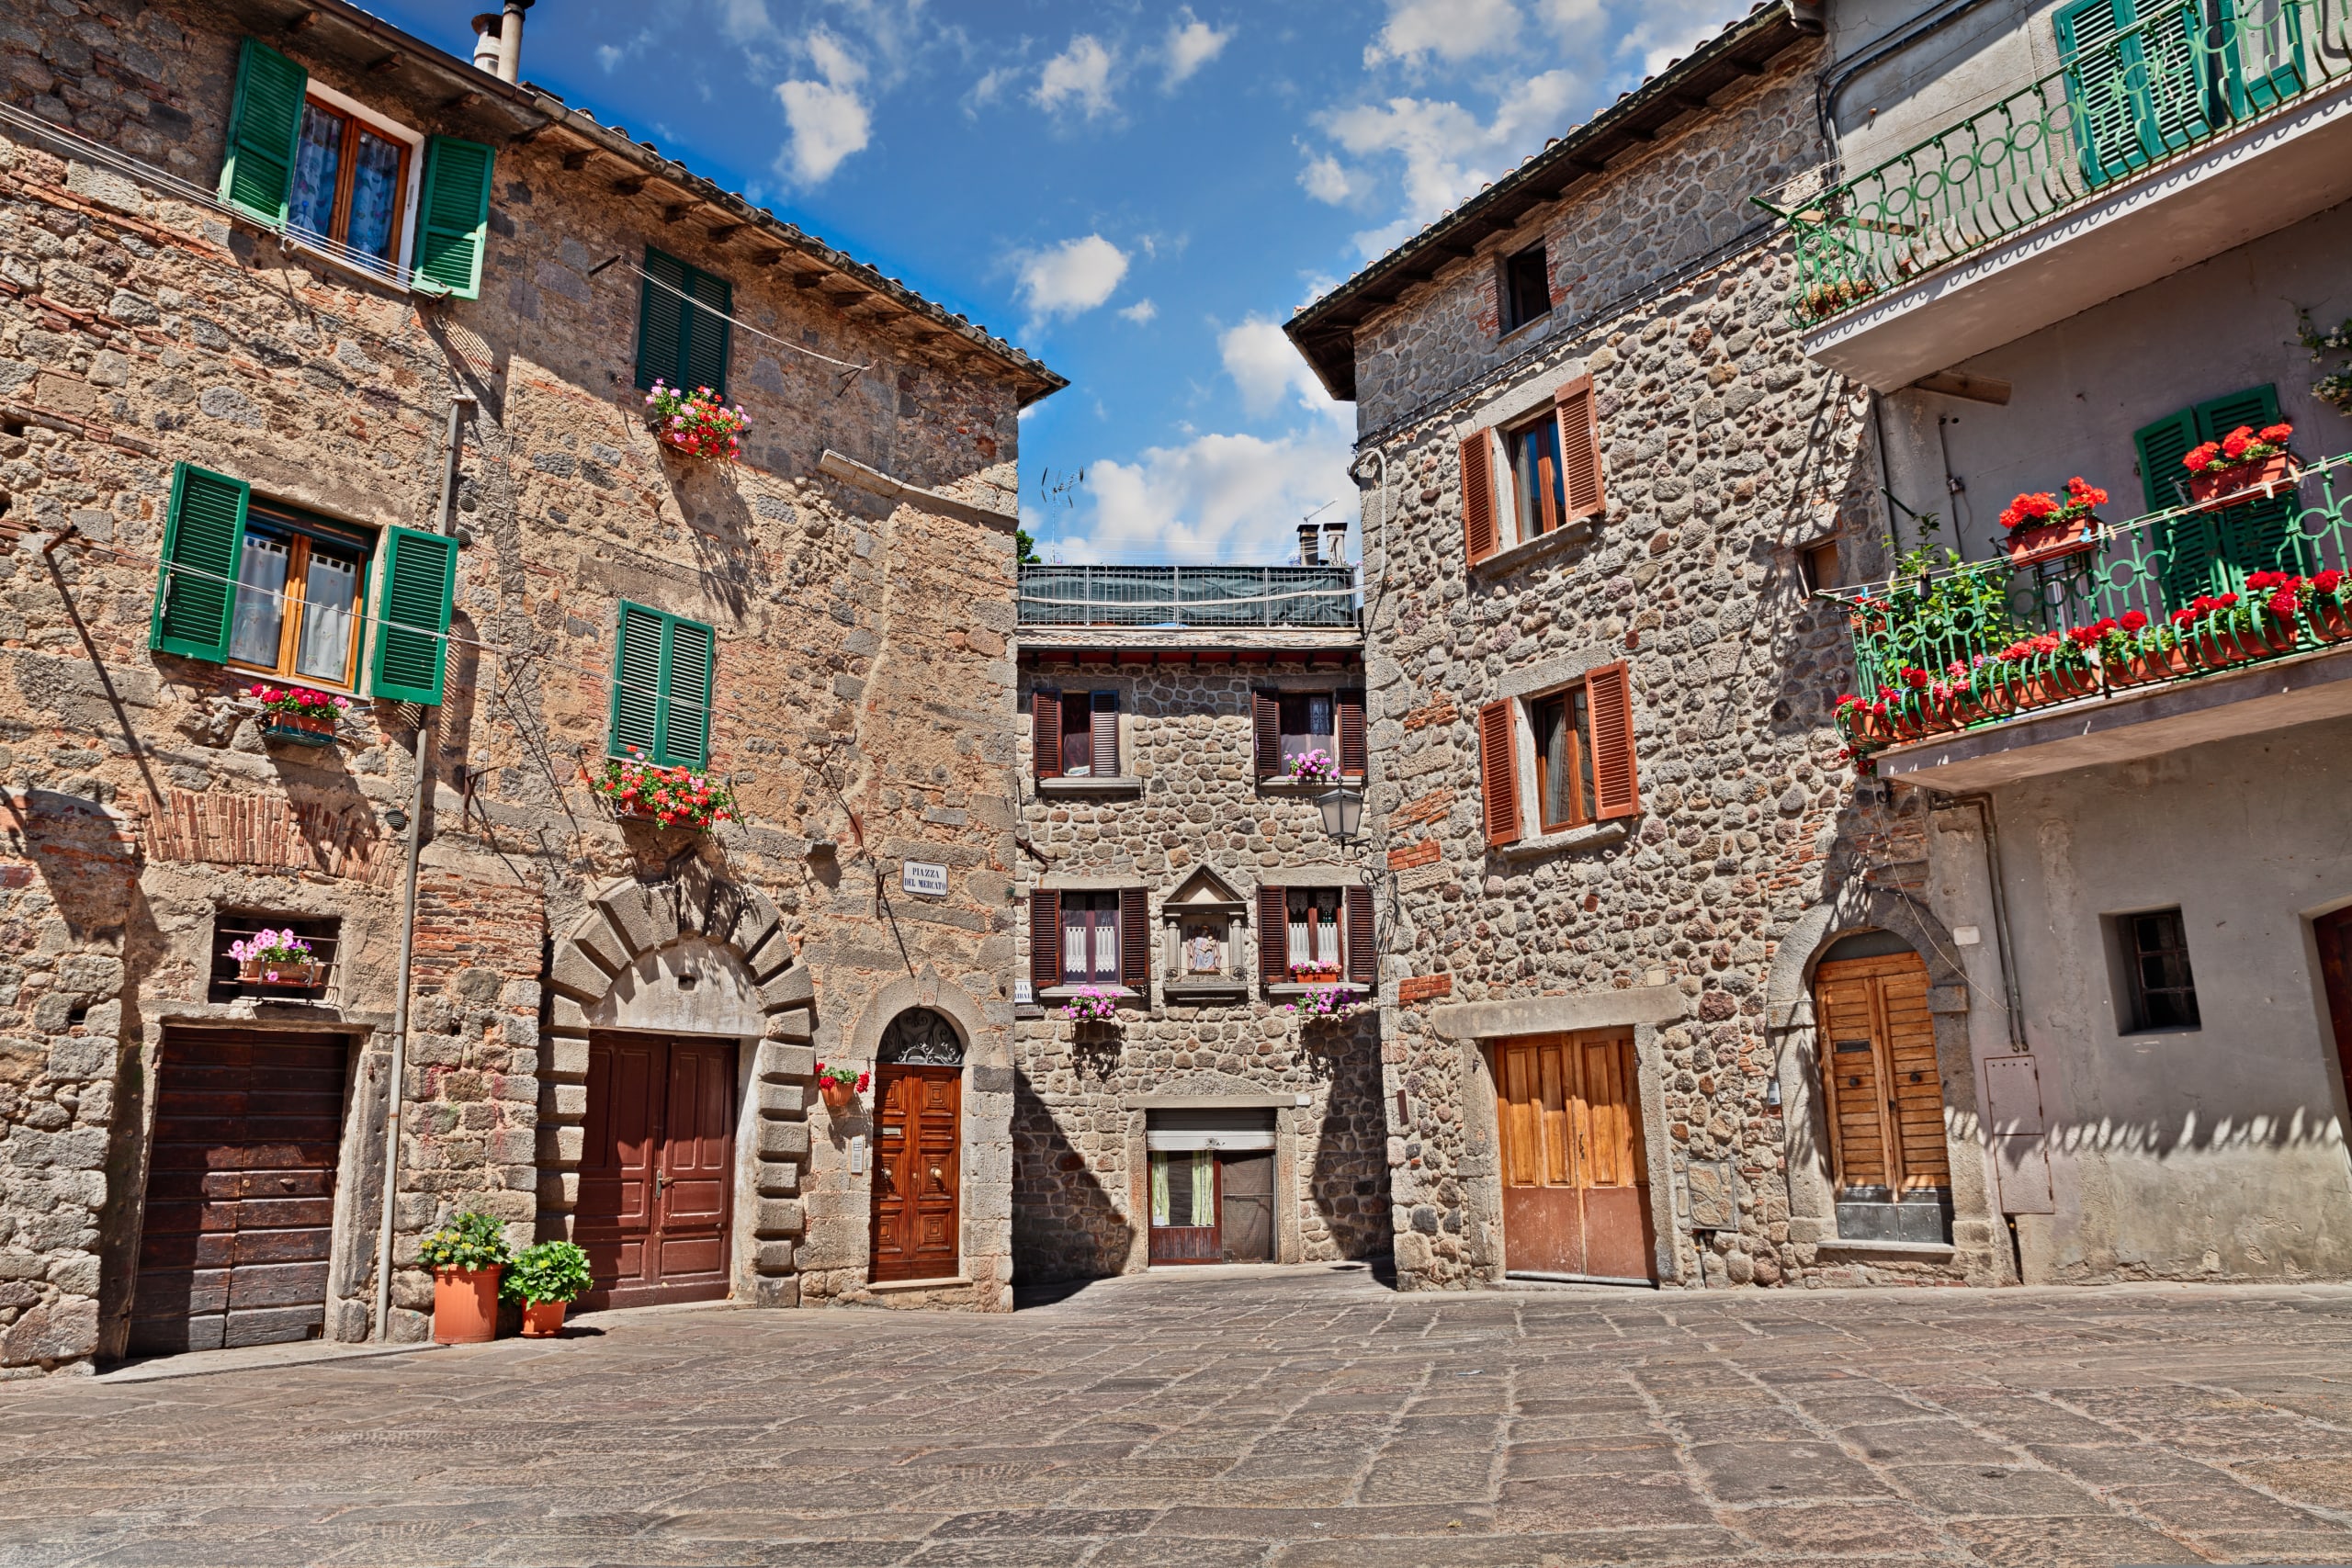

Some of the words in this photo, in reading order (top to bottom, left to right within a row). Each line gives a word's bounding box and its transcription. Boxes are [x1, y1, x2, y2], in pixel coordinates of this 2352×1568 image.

[912, 867, 940, 879] PIAZZA
[904, 877, 916, 887] DEL
[918, 879, 946, 891] MERCATO
